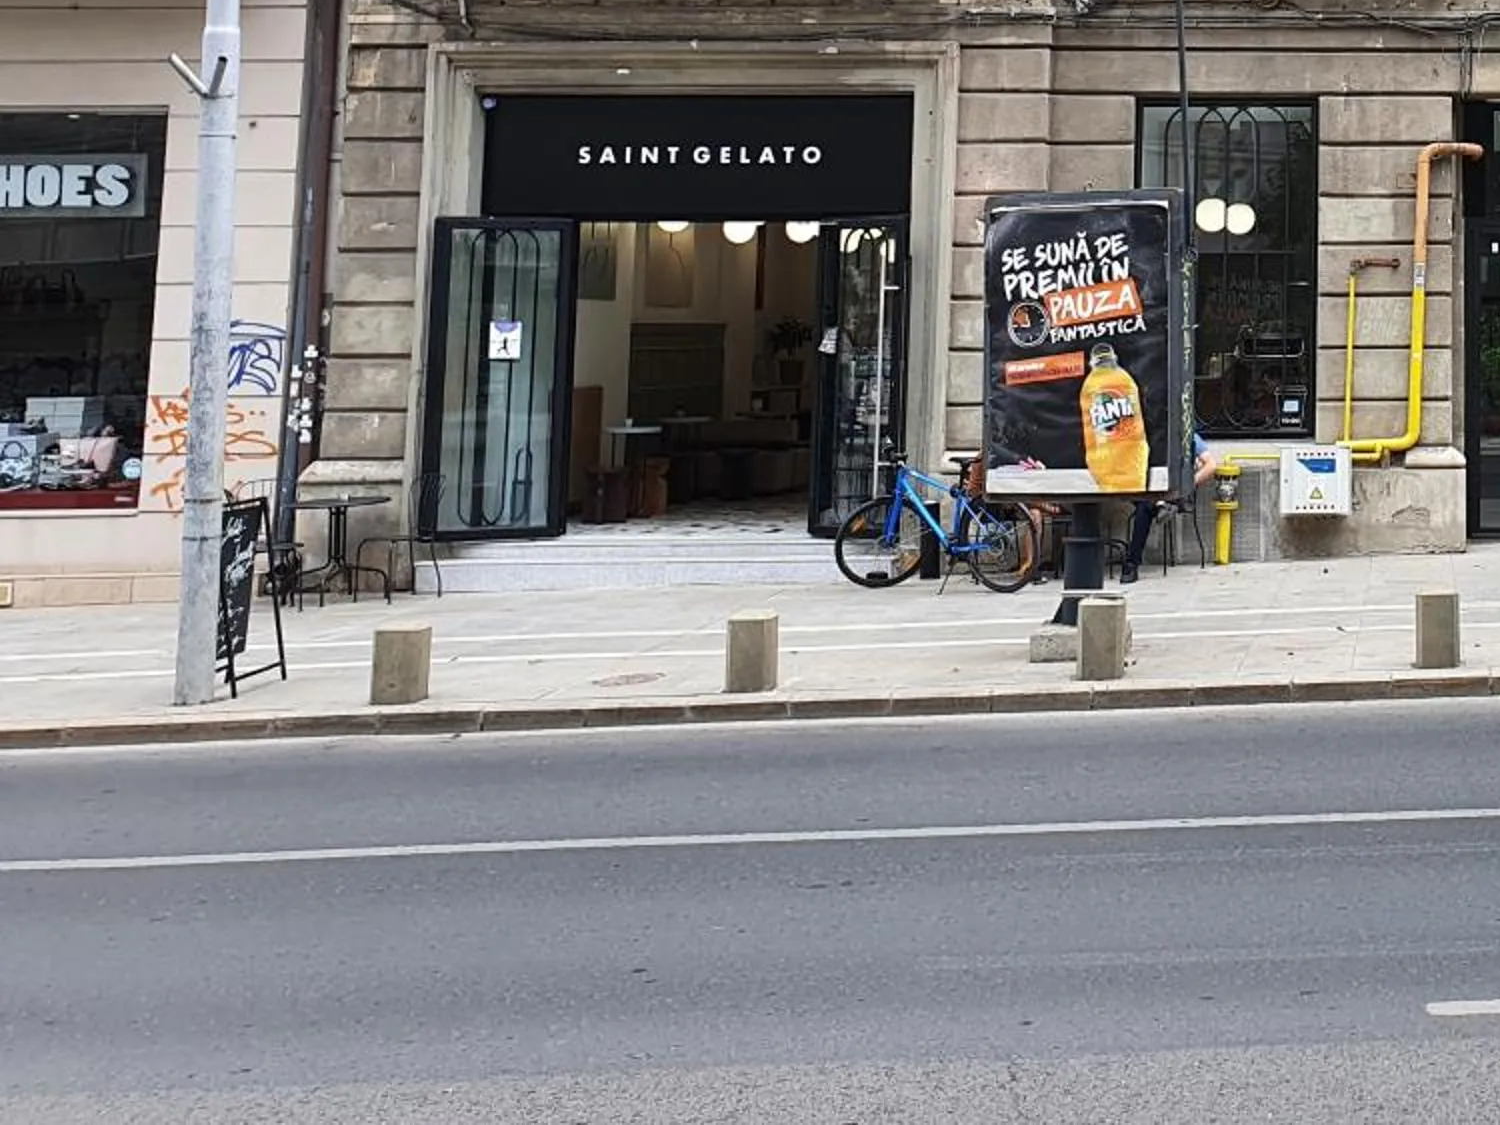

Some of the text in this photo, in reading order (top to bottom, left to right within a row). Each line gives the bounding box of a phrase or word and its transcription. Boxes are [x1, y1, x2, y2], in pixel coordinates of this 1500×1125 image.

[578, 146, 822, 164] SAINT GELATO
[0, 164, 130, 207] HOES
[1001, 231, 1129, 273] SE SUNĂ DE
[1003, 256, 1129, 302] PREMII ÎN
[1049, 283, 1136, 328] PAUZA
[1050, 314, 1147, 343] FANTASTICĂ
